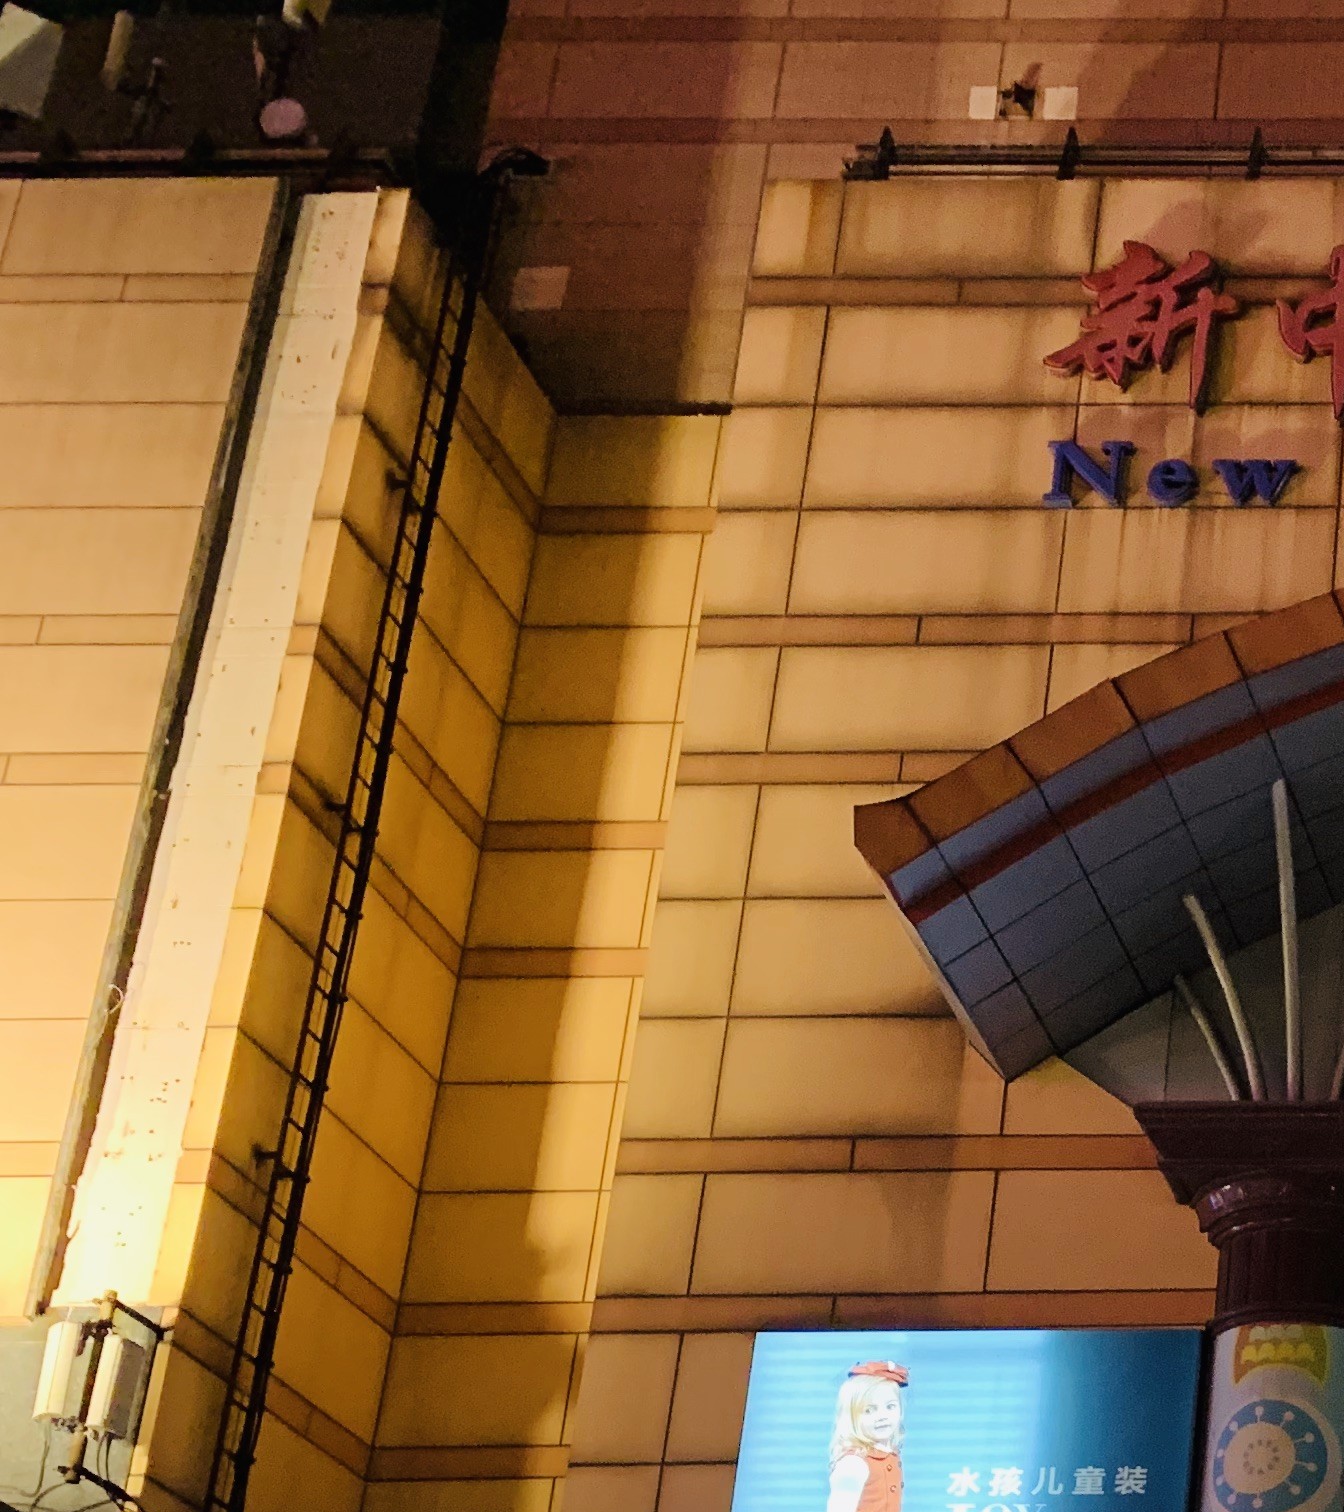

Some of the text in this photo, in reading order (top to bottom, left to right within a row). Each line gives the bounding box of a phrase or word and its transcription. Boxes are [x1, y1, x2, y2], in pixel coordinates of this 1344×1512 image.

[1042, 439, 1300, 509] New
[947, 1466, 1149, 1498] 水孩儿童装
